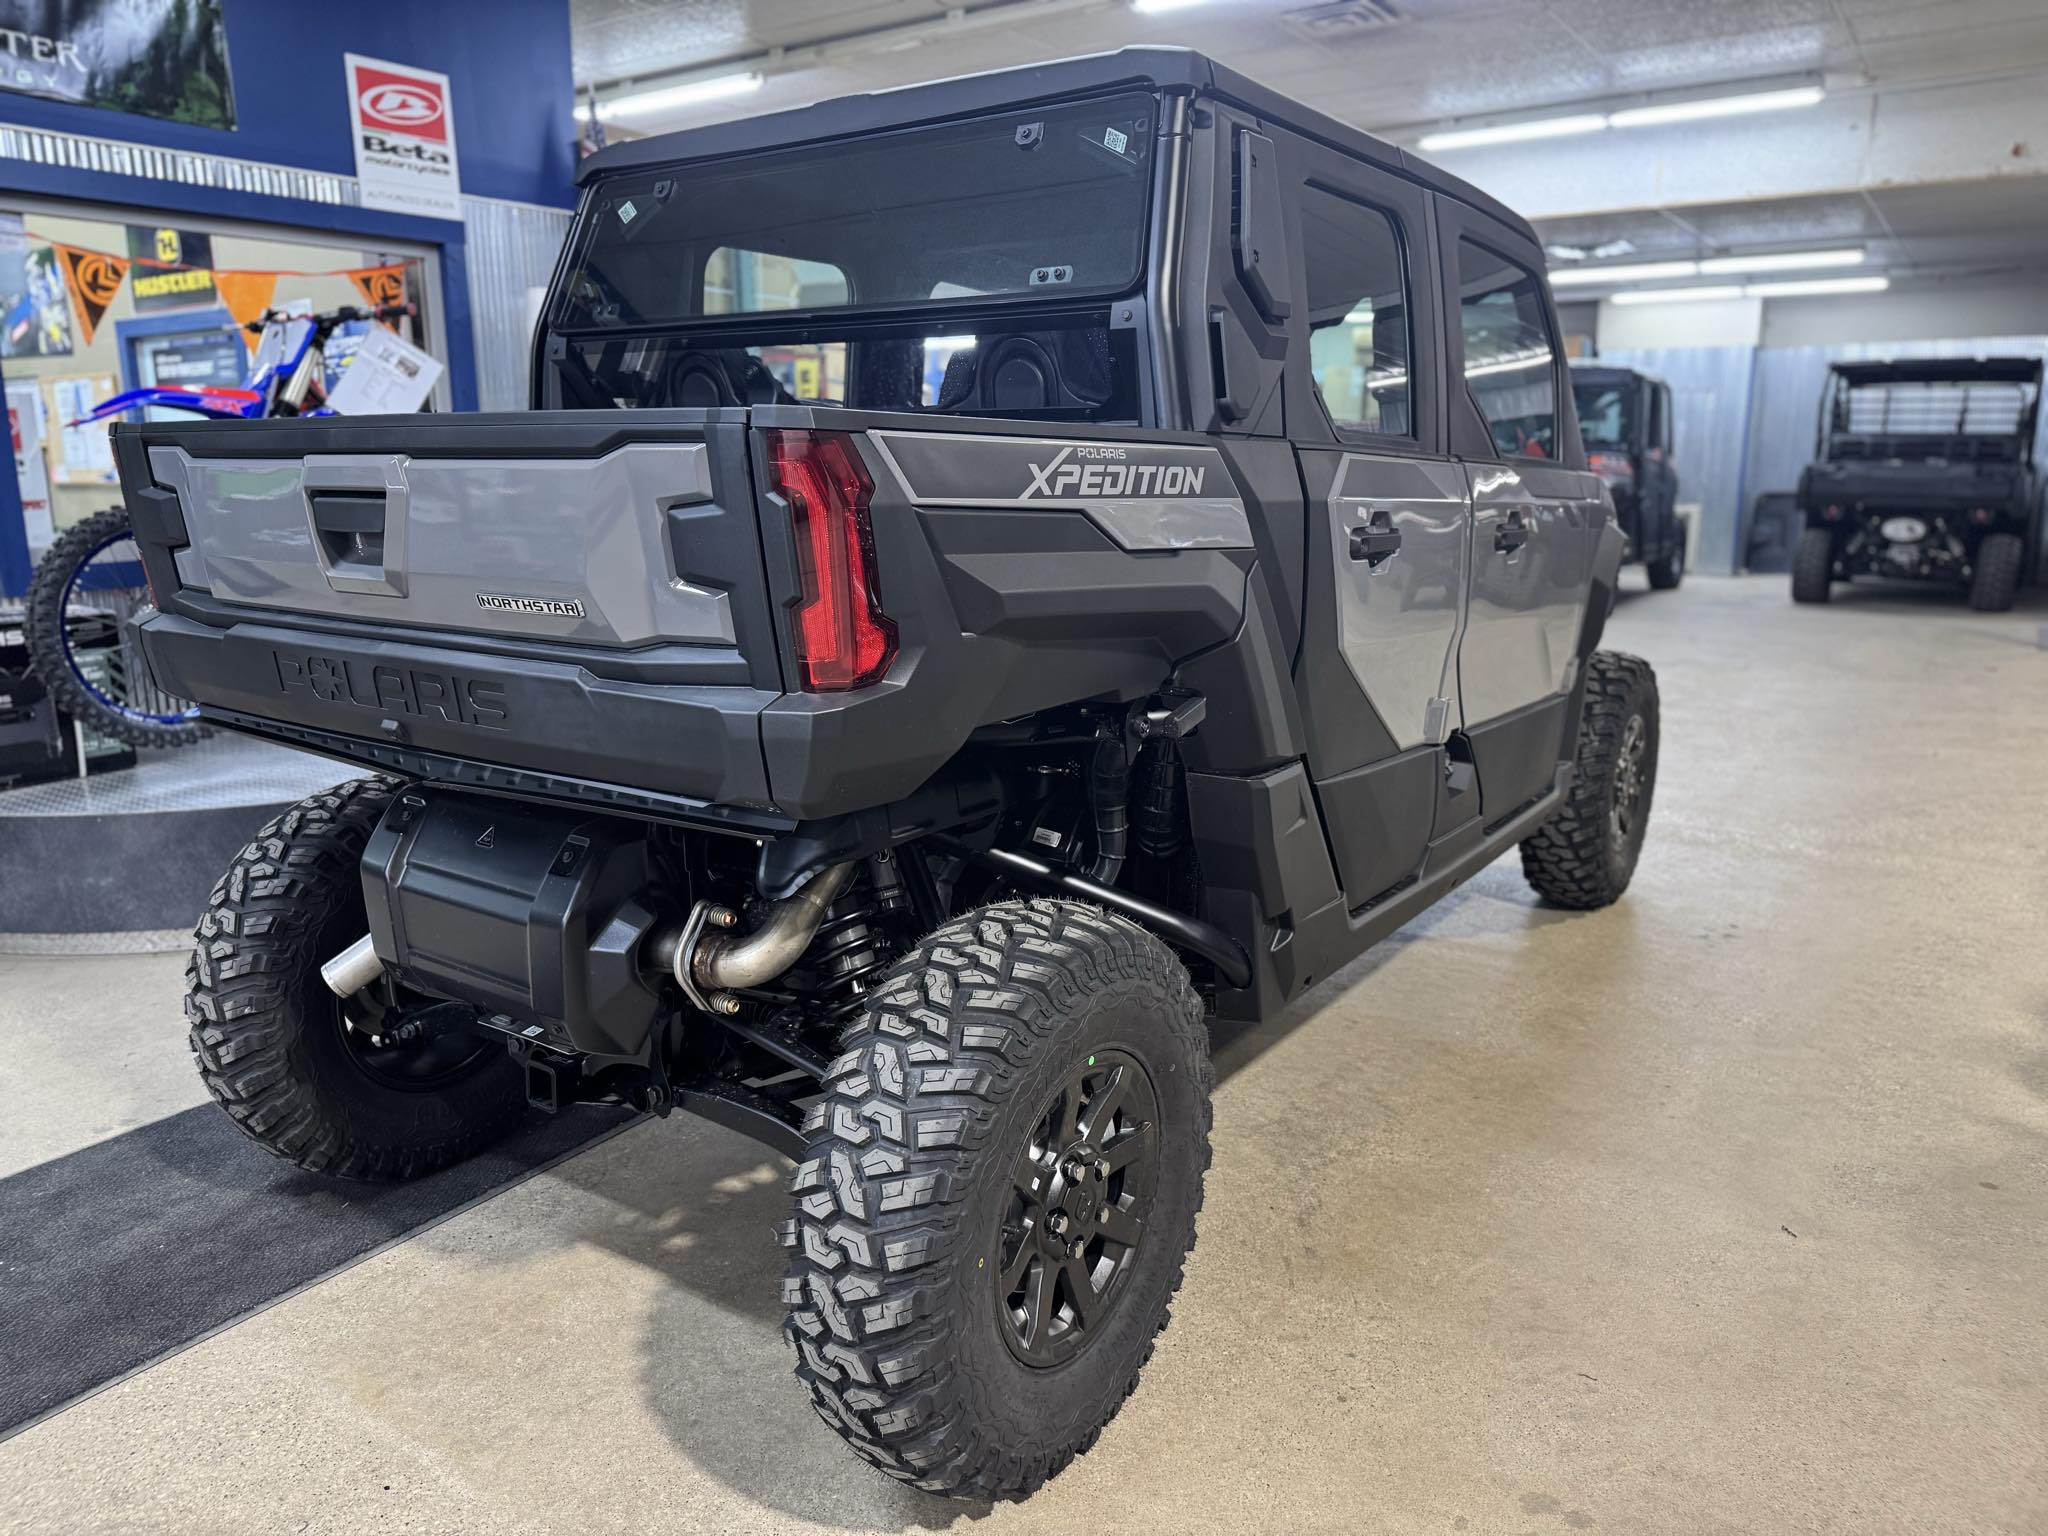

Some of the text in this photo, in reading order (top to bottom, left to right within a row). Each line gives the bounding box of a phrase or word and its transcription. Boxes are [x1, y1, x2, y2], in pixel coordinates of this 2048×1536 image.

[362, 135, 449, 165] Beta
[364, 155, 451, 176] motorcycles
[1077, 447, 1127, 461] POLARIS
[1018, 447, 1205, 499] XPEDITION
[479, 595, 578, 616] NORTHSTAR
[272, 650, 512, 733] POLARIS
